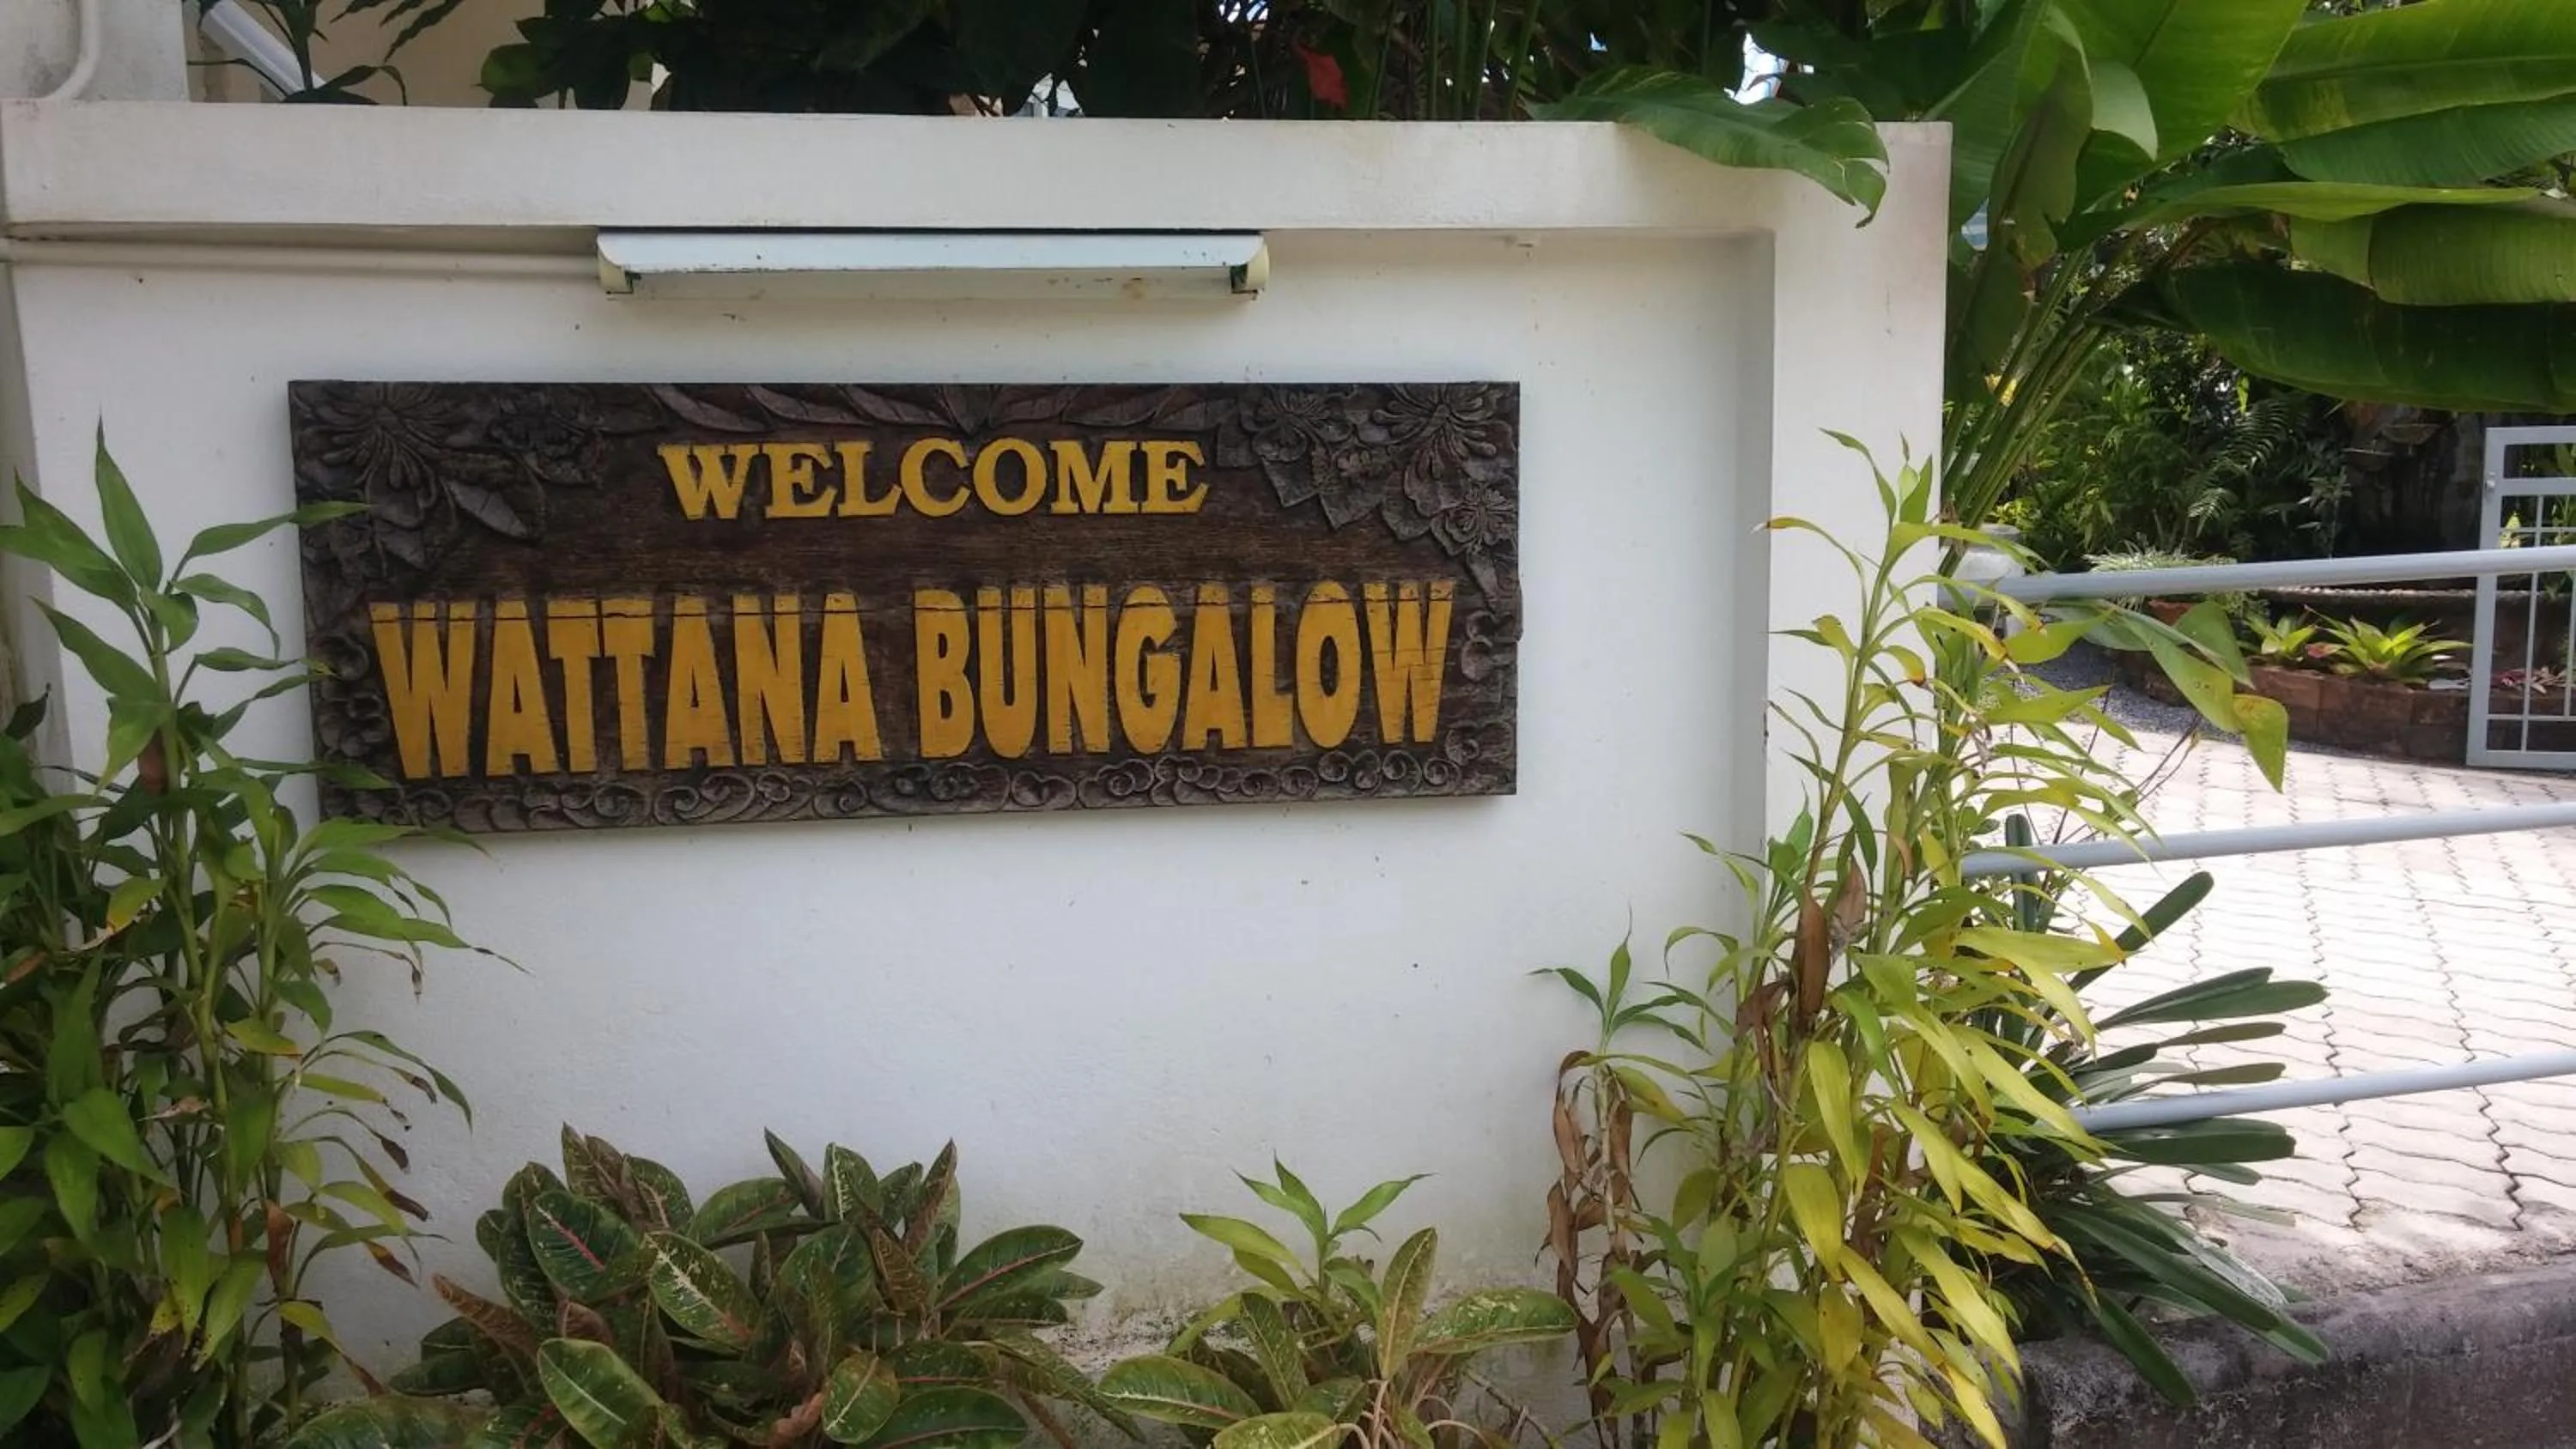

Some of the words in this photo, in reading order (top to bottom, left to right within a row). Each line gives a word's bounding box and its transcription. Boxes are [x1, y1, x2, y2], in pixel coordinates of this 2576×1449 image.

[657, 437, 1209, 520] WELCOME
[369, 591, 882, 779] WATTANA
[914, 579, 1456, 759] BUNGALOW
